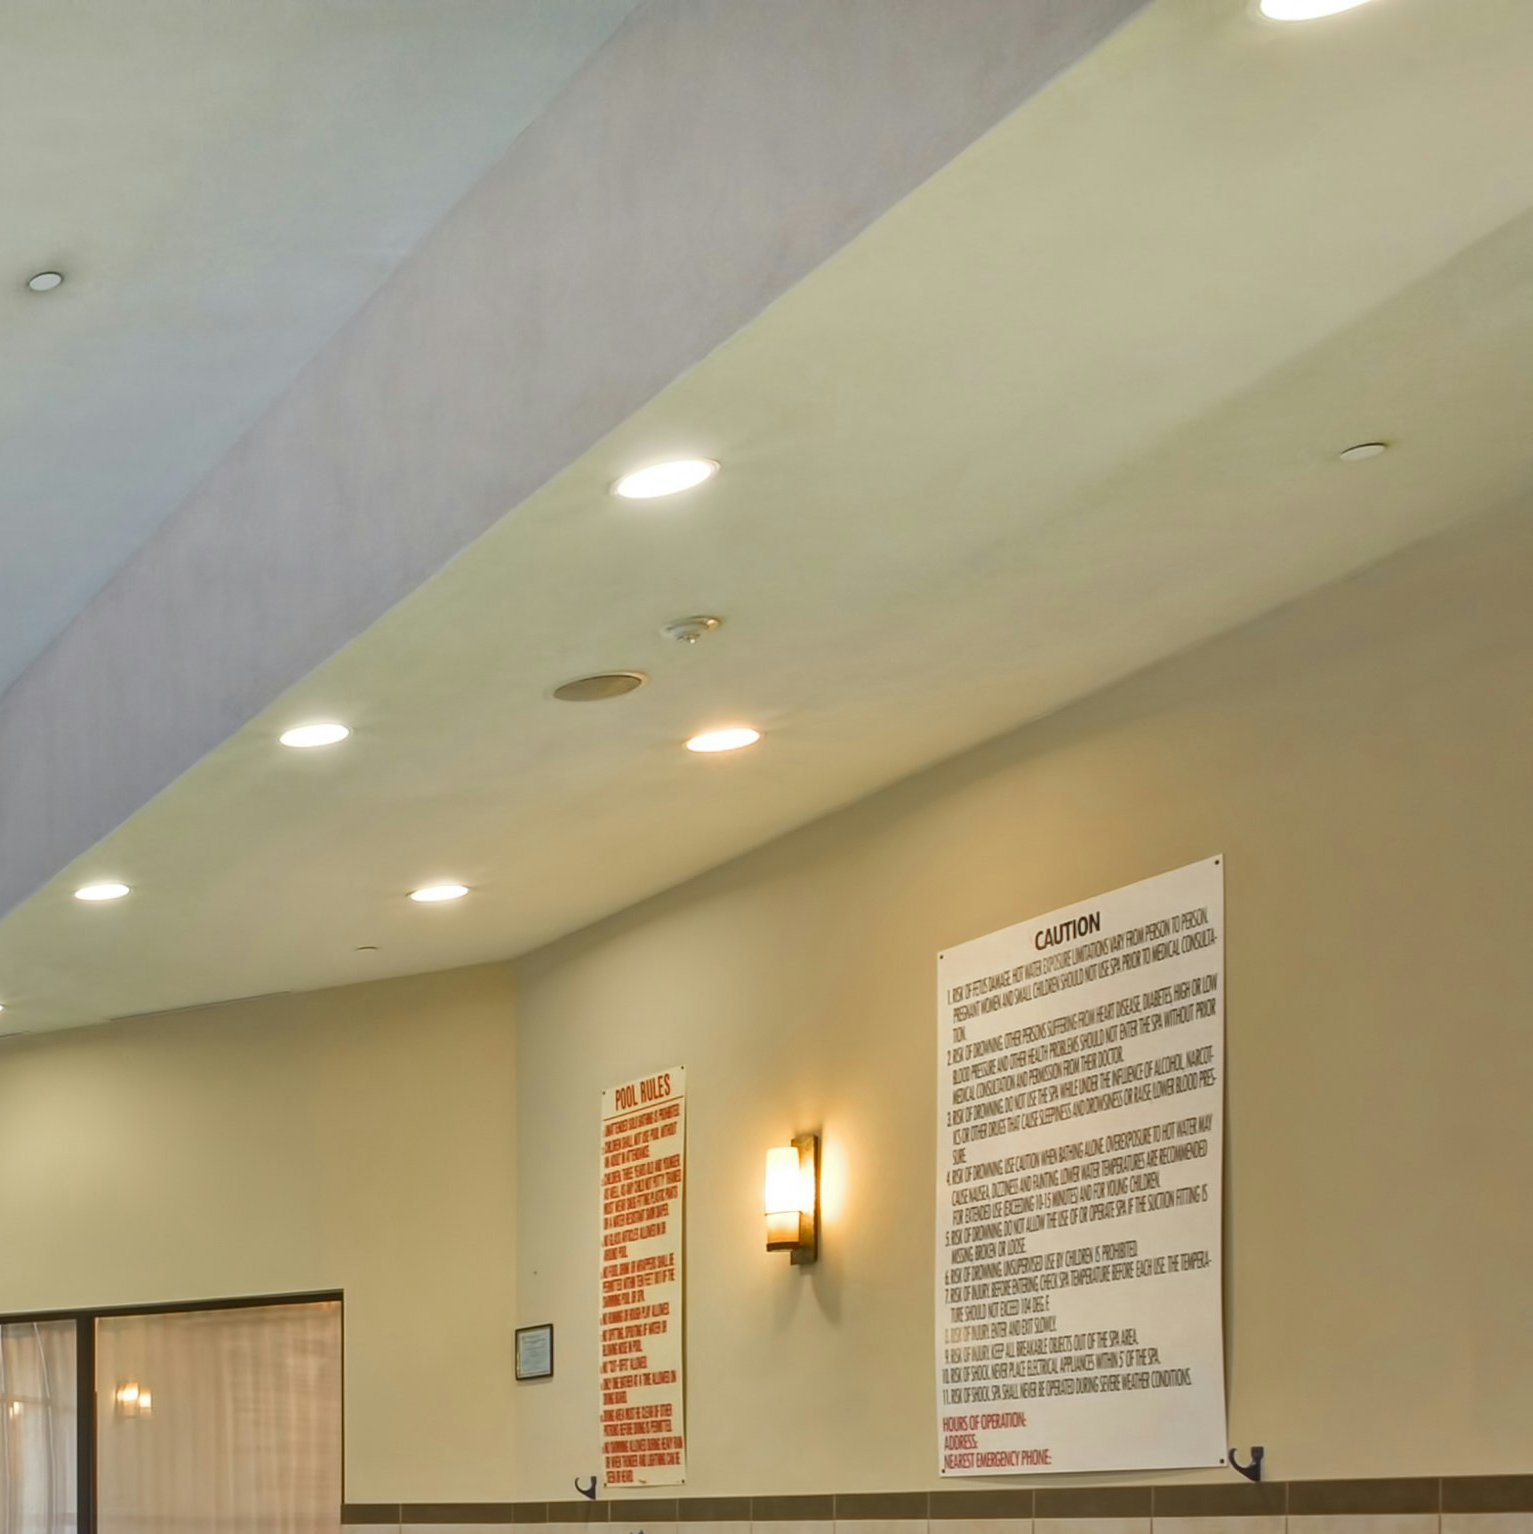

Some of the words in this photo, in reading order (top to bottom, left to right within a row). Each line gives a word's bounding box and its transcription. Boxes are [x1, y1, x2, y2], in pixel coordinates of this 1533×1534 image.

[1034, 911, 1100, 951] CAUTION
[615, 1086, 638, 1111] POOL
[640, 1073, 671, 1103] RULES
[942, 1416, 968, 1432] HOURS
[968, 1415, 979, 1430] OF
[943, 1453, 974, 1469] NEAREST
[975, 1451, 1019, 1468] EMERGENCY
